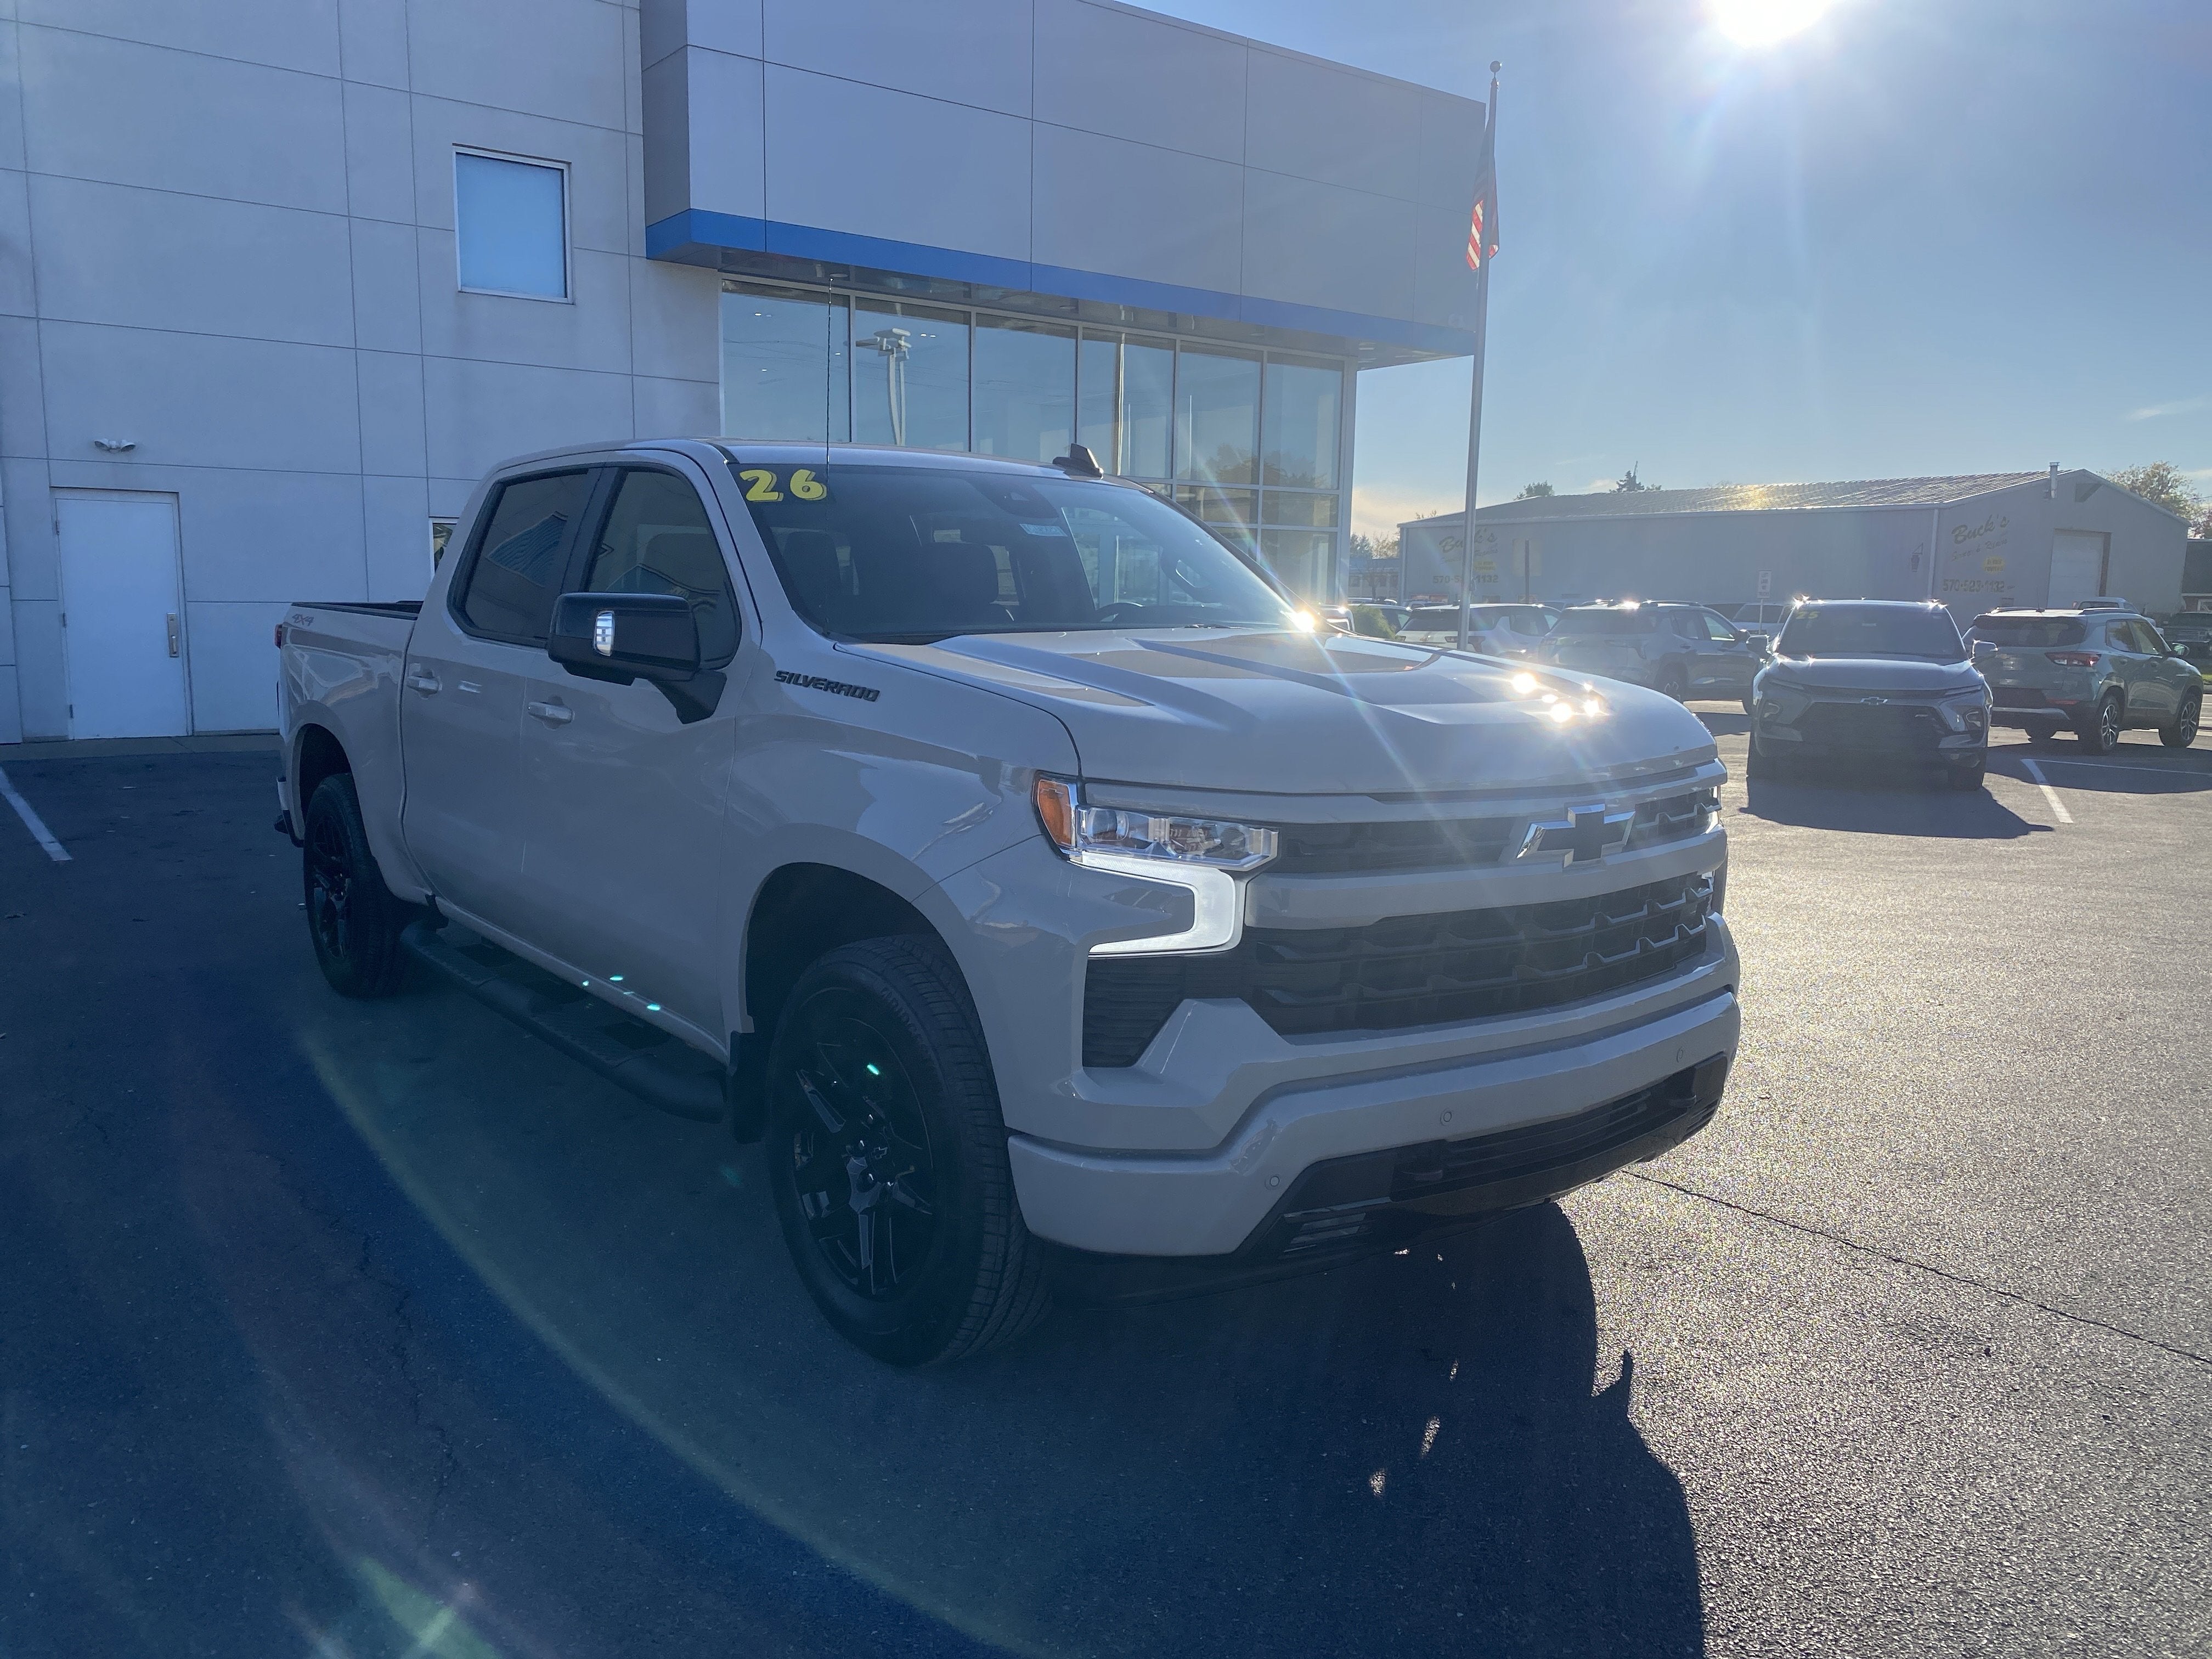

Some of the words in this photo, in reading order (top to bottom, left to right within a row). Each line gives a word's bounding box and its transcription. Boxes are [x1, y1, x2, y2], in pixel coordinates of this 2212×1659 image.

[739, 469, 827, 502] 26
[1438, 528, 1498, 553] Buk's
[1951, 514, 2010, 544] Buck's
[1432, 574, 1499, 584] 570-5-1132
[1796, 611, 1820, 619] 25
[774, 670, 881, 702] SILVERADO
